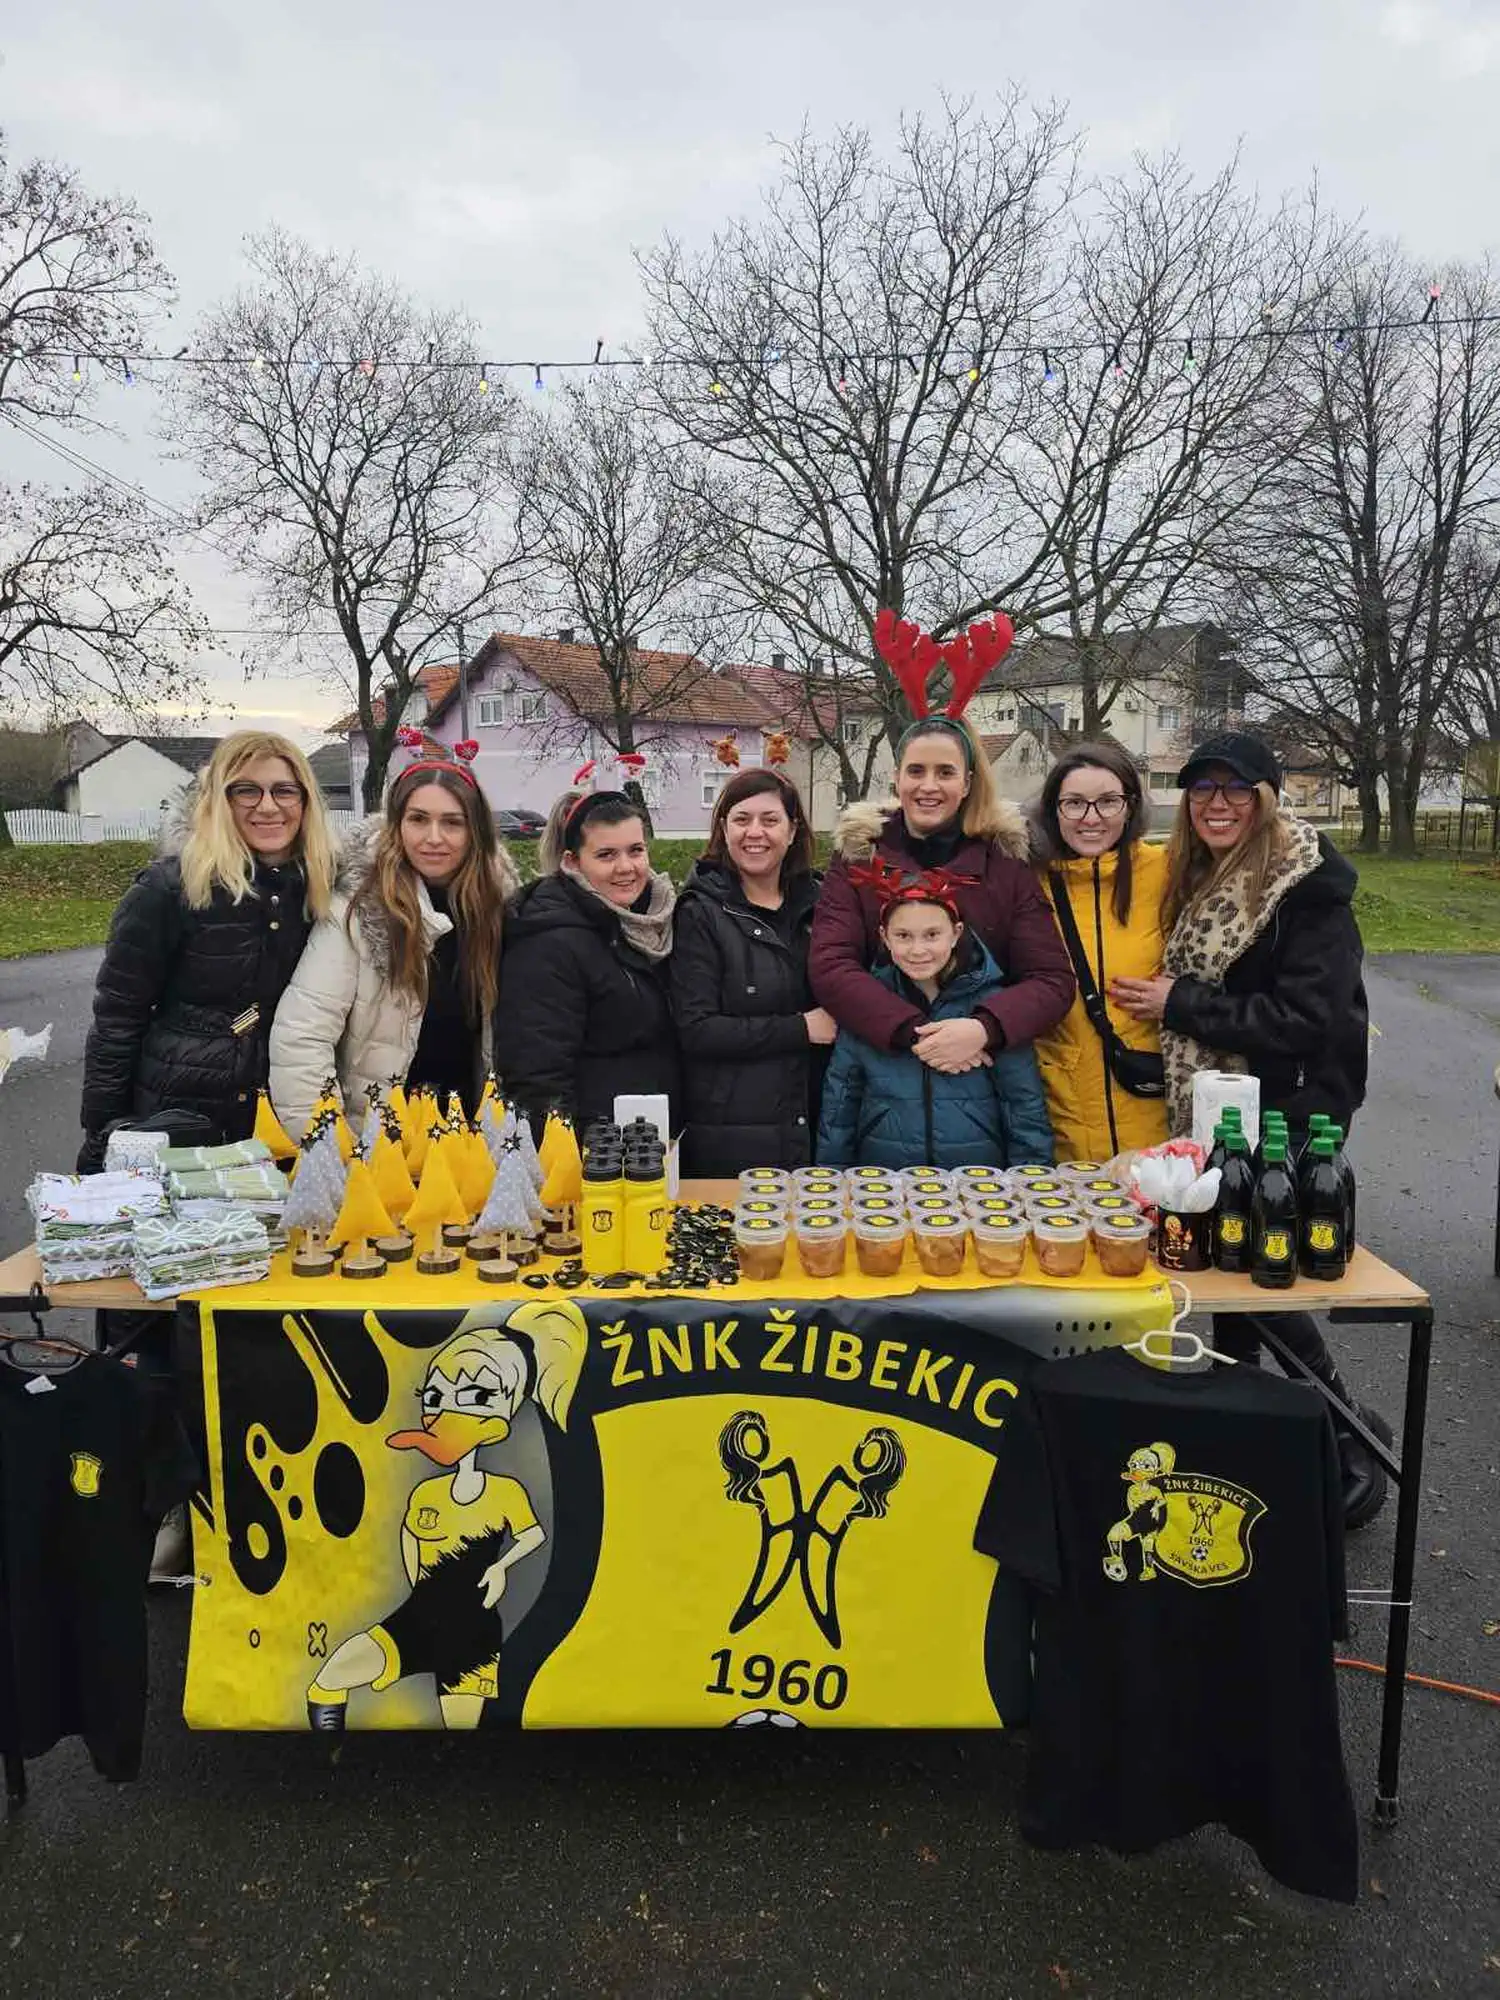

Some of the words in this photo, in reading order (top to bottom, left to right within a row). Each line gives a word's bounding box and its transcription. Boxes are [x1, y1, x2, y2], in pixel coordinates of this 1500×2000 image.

[600, 1320, 741, 1387] ŽNK
[1163, 1479, 1190, 1490] ŽNK
[1192, 1479, 1250, 1507] ŽIBEKICE
[1189, 1535, 1214, 1547] 1960
[705, 1648, 849, 1711] 1960
